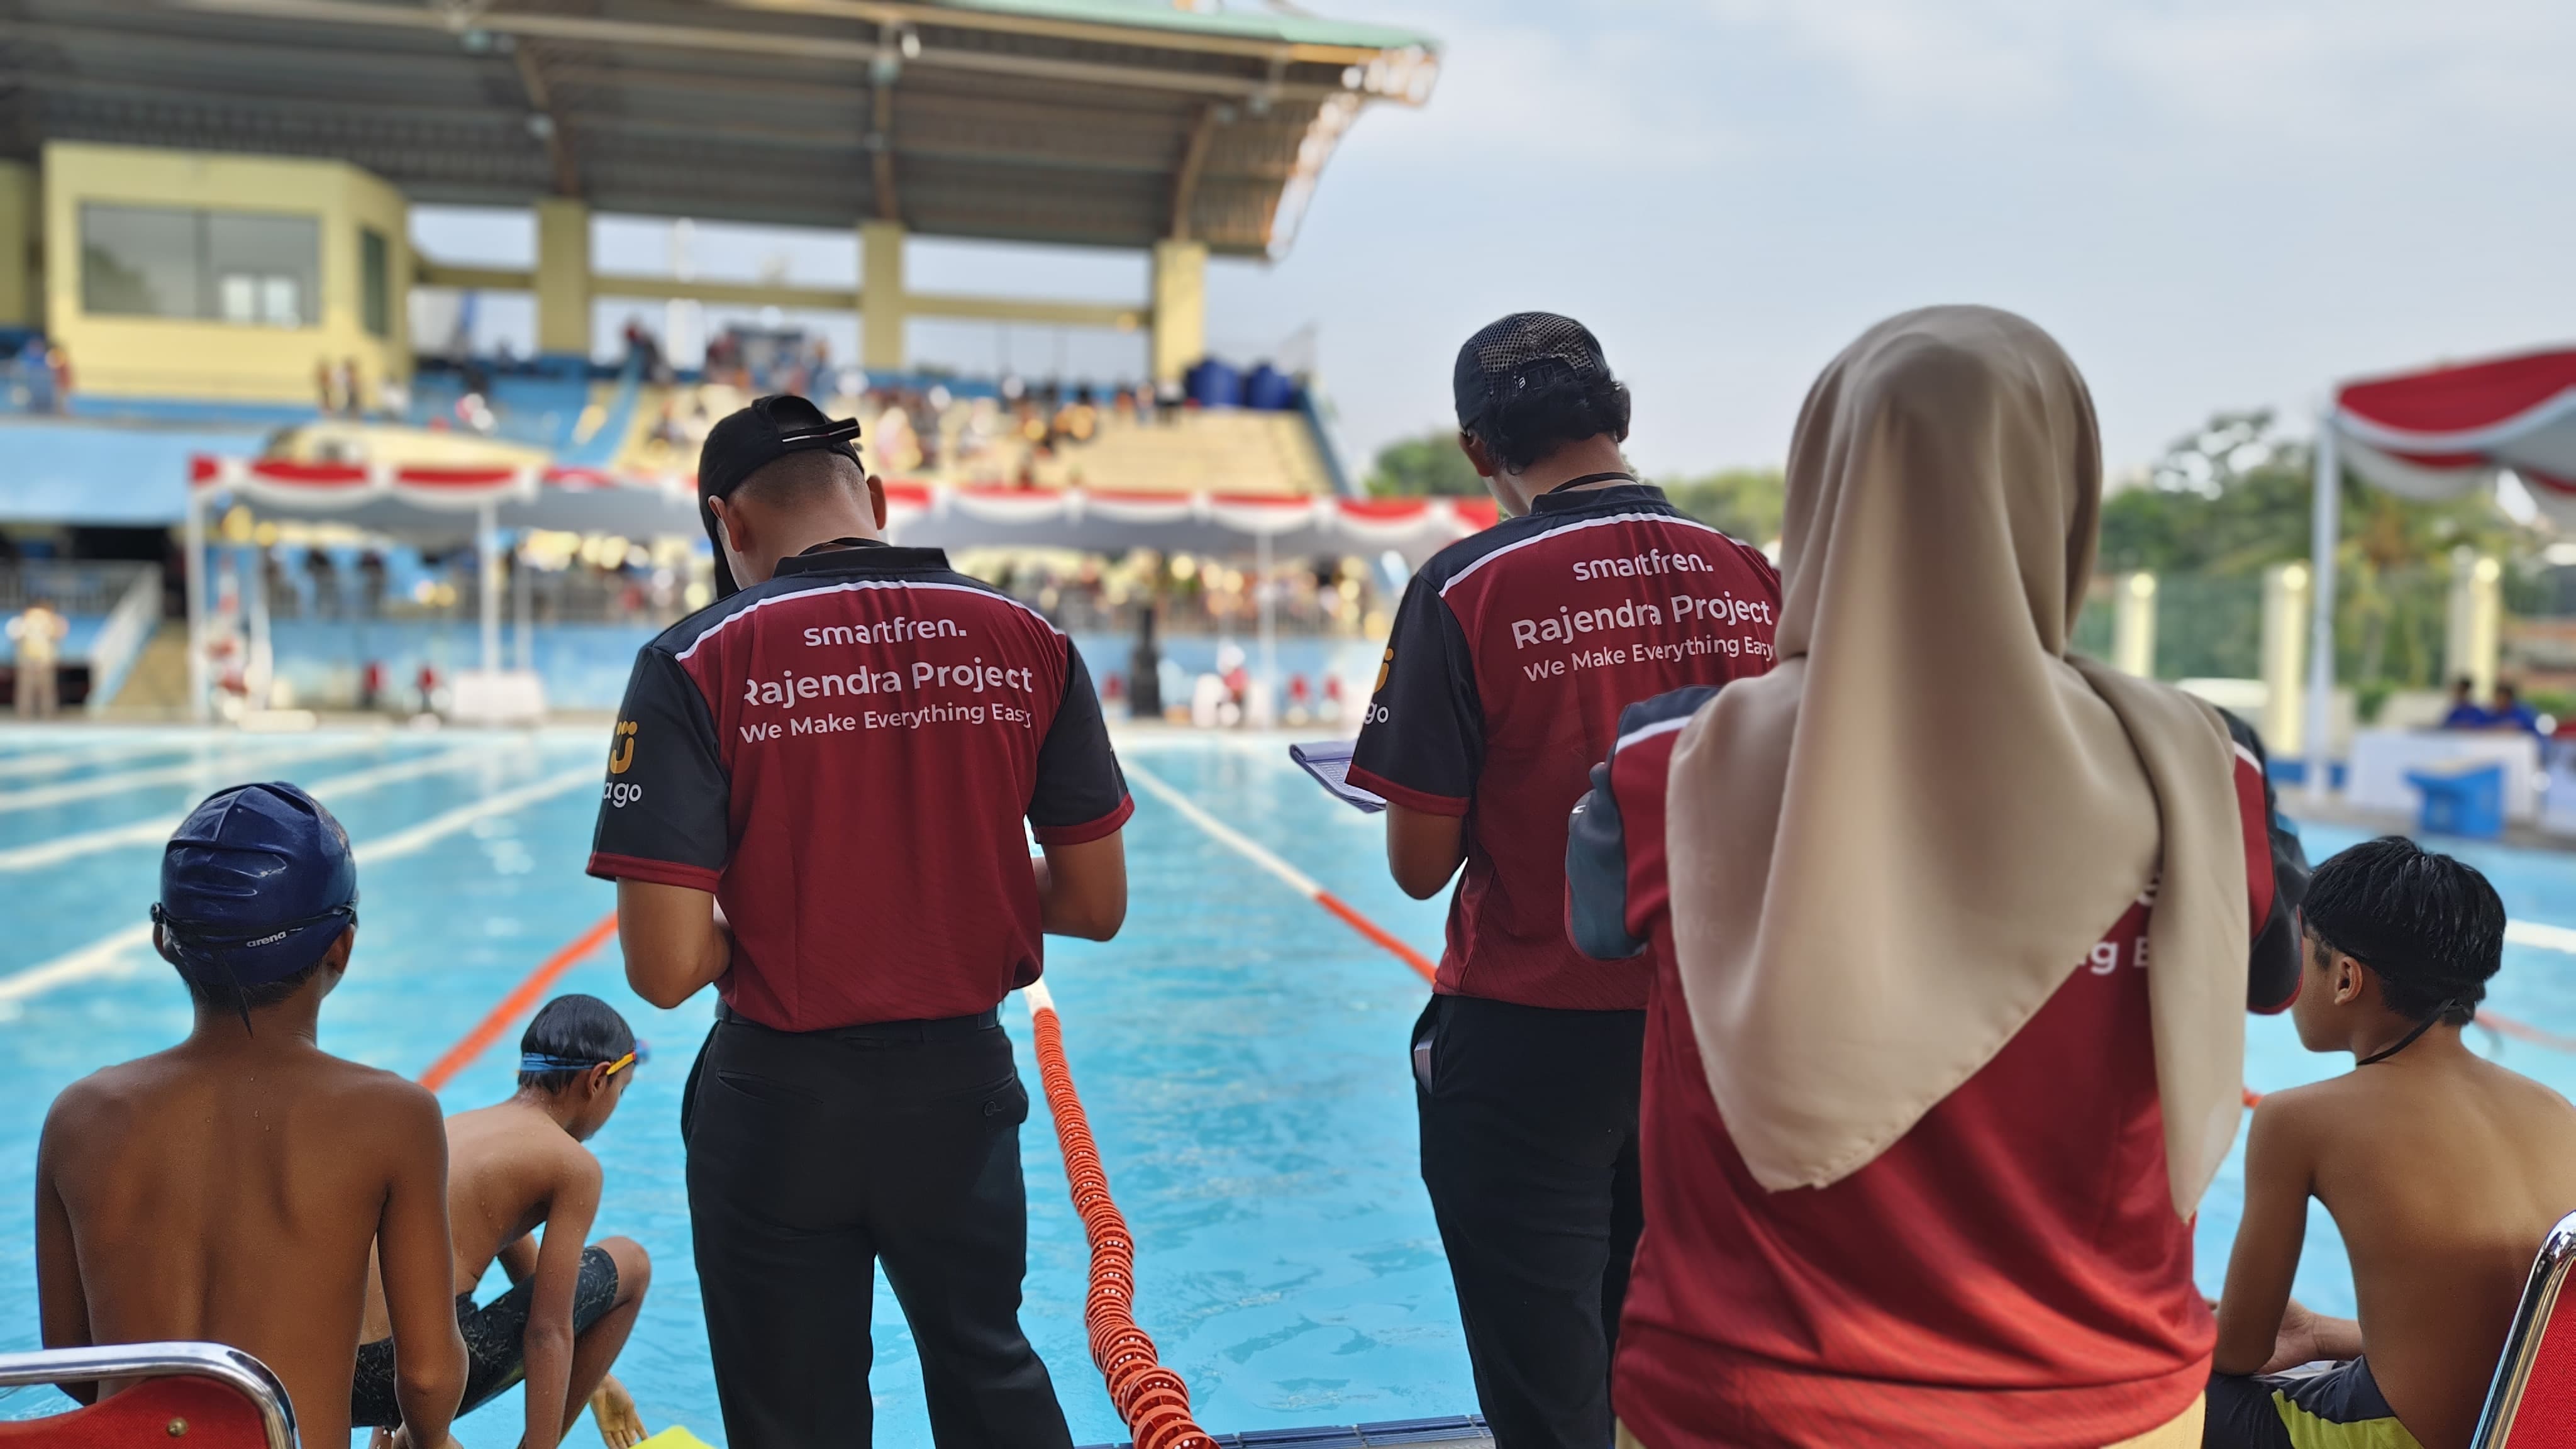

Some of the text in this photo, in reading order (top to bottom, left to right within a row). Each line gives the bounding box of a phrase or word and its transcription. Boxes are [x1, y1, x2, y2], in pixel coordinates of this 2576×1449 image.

[804, 616, 967, 647] smartfren.
[1511, 590, 1773, 650] Rajendra Project
[1523, 658, 1566, 682] We
[1572, 644, 1626, 671] Make
[1633, 635, 1740, 663] Everything
[744, 657, 1033, 709] Rajendra Project
[740, 721, 783, 745] We
[790, 713, 857, 736] Make
[863, 702, 985, 730] Everything
[247, 931, 287, 947] arena
